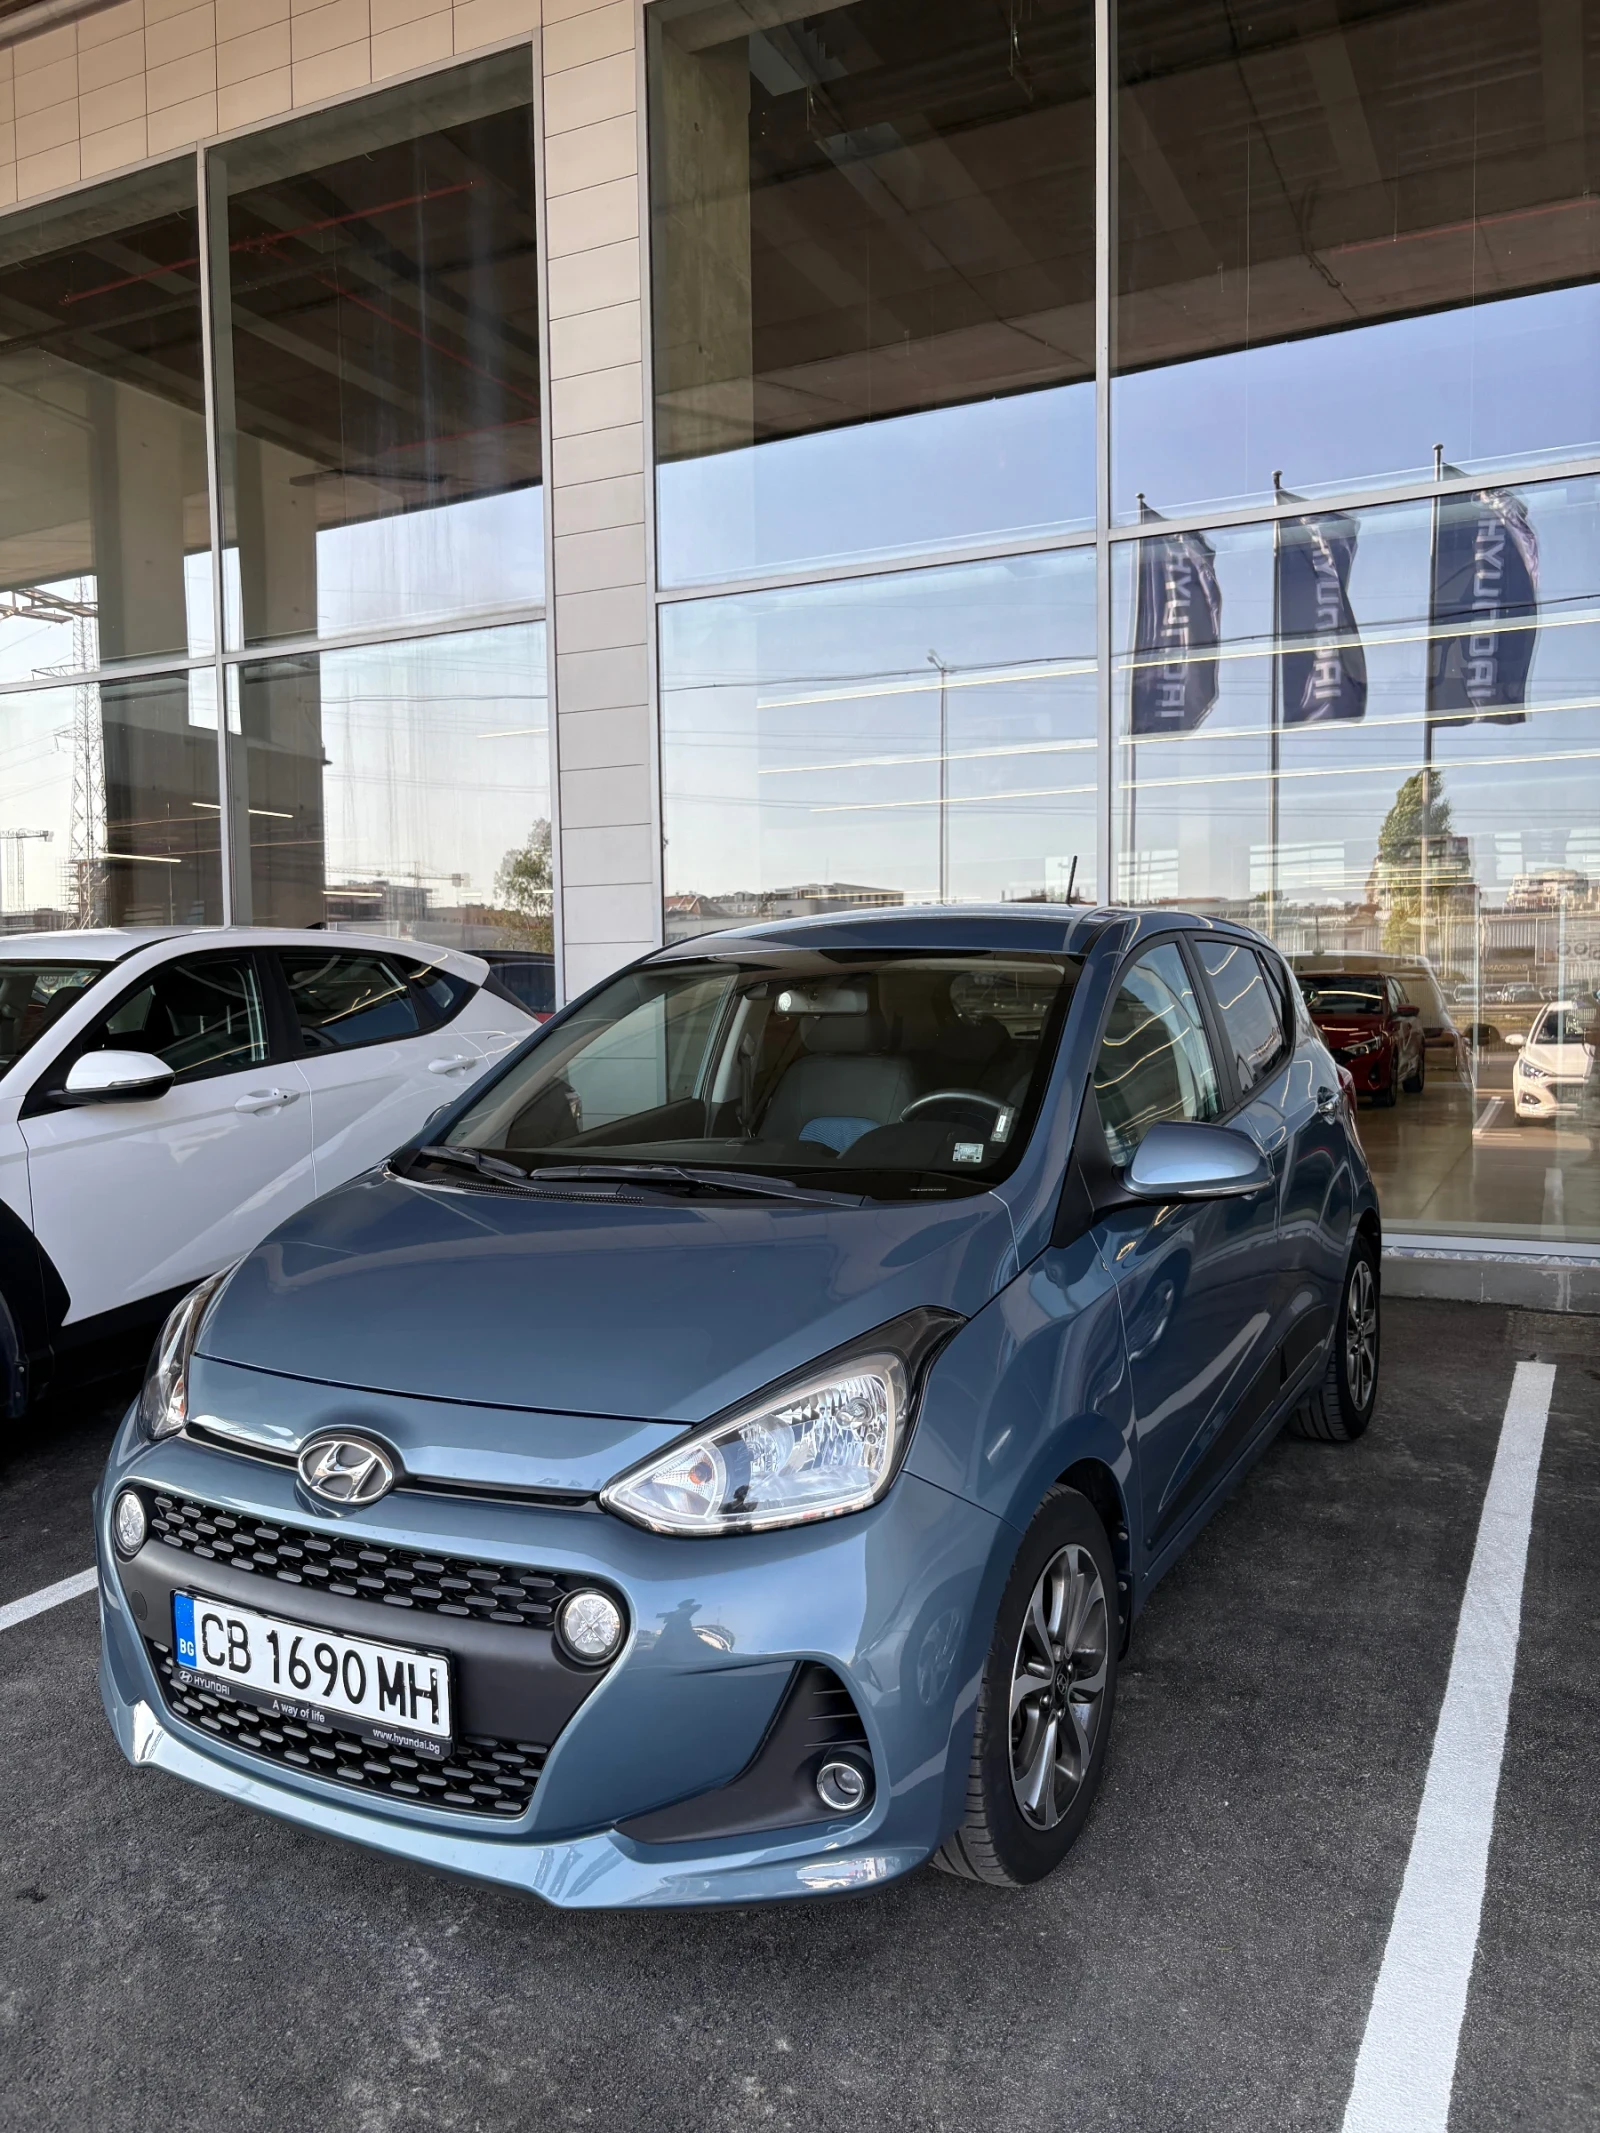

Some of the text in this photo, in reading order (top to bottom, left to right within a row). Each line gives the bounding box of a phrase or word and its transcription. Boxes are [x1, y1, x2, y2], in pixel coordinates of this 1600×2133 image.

[1466, 519, 1506, 699] HYUNDAI
[180, 1637, 195, 1657] BG
[202, 1613, 440, 1725] CB 1690 MH
[194, 1675, 230, 1696] HYUNDAI
[272, 1699, 326, 1723] A way of life
[372, 1728, 441, 1755] www.hyundai.bg
